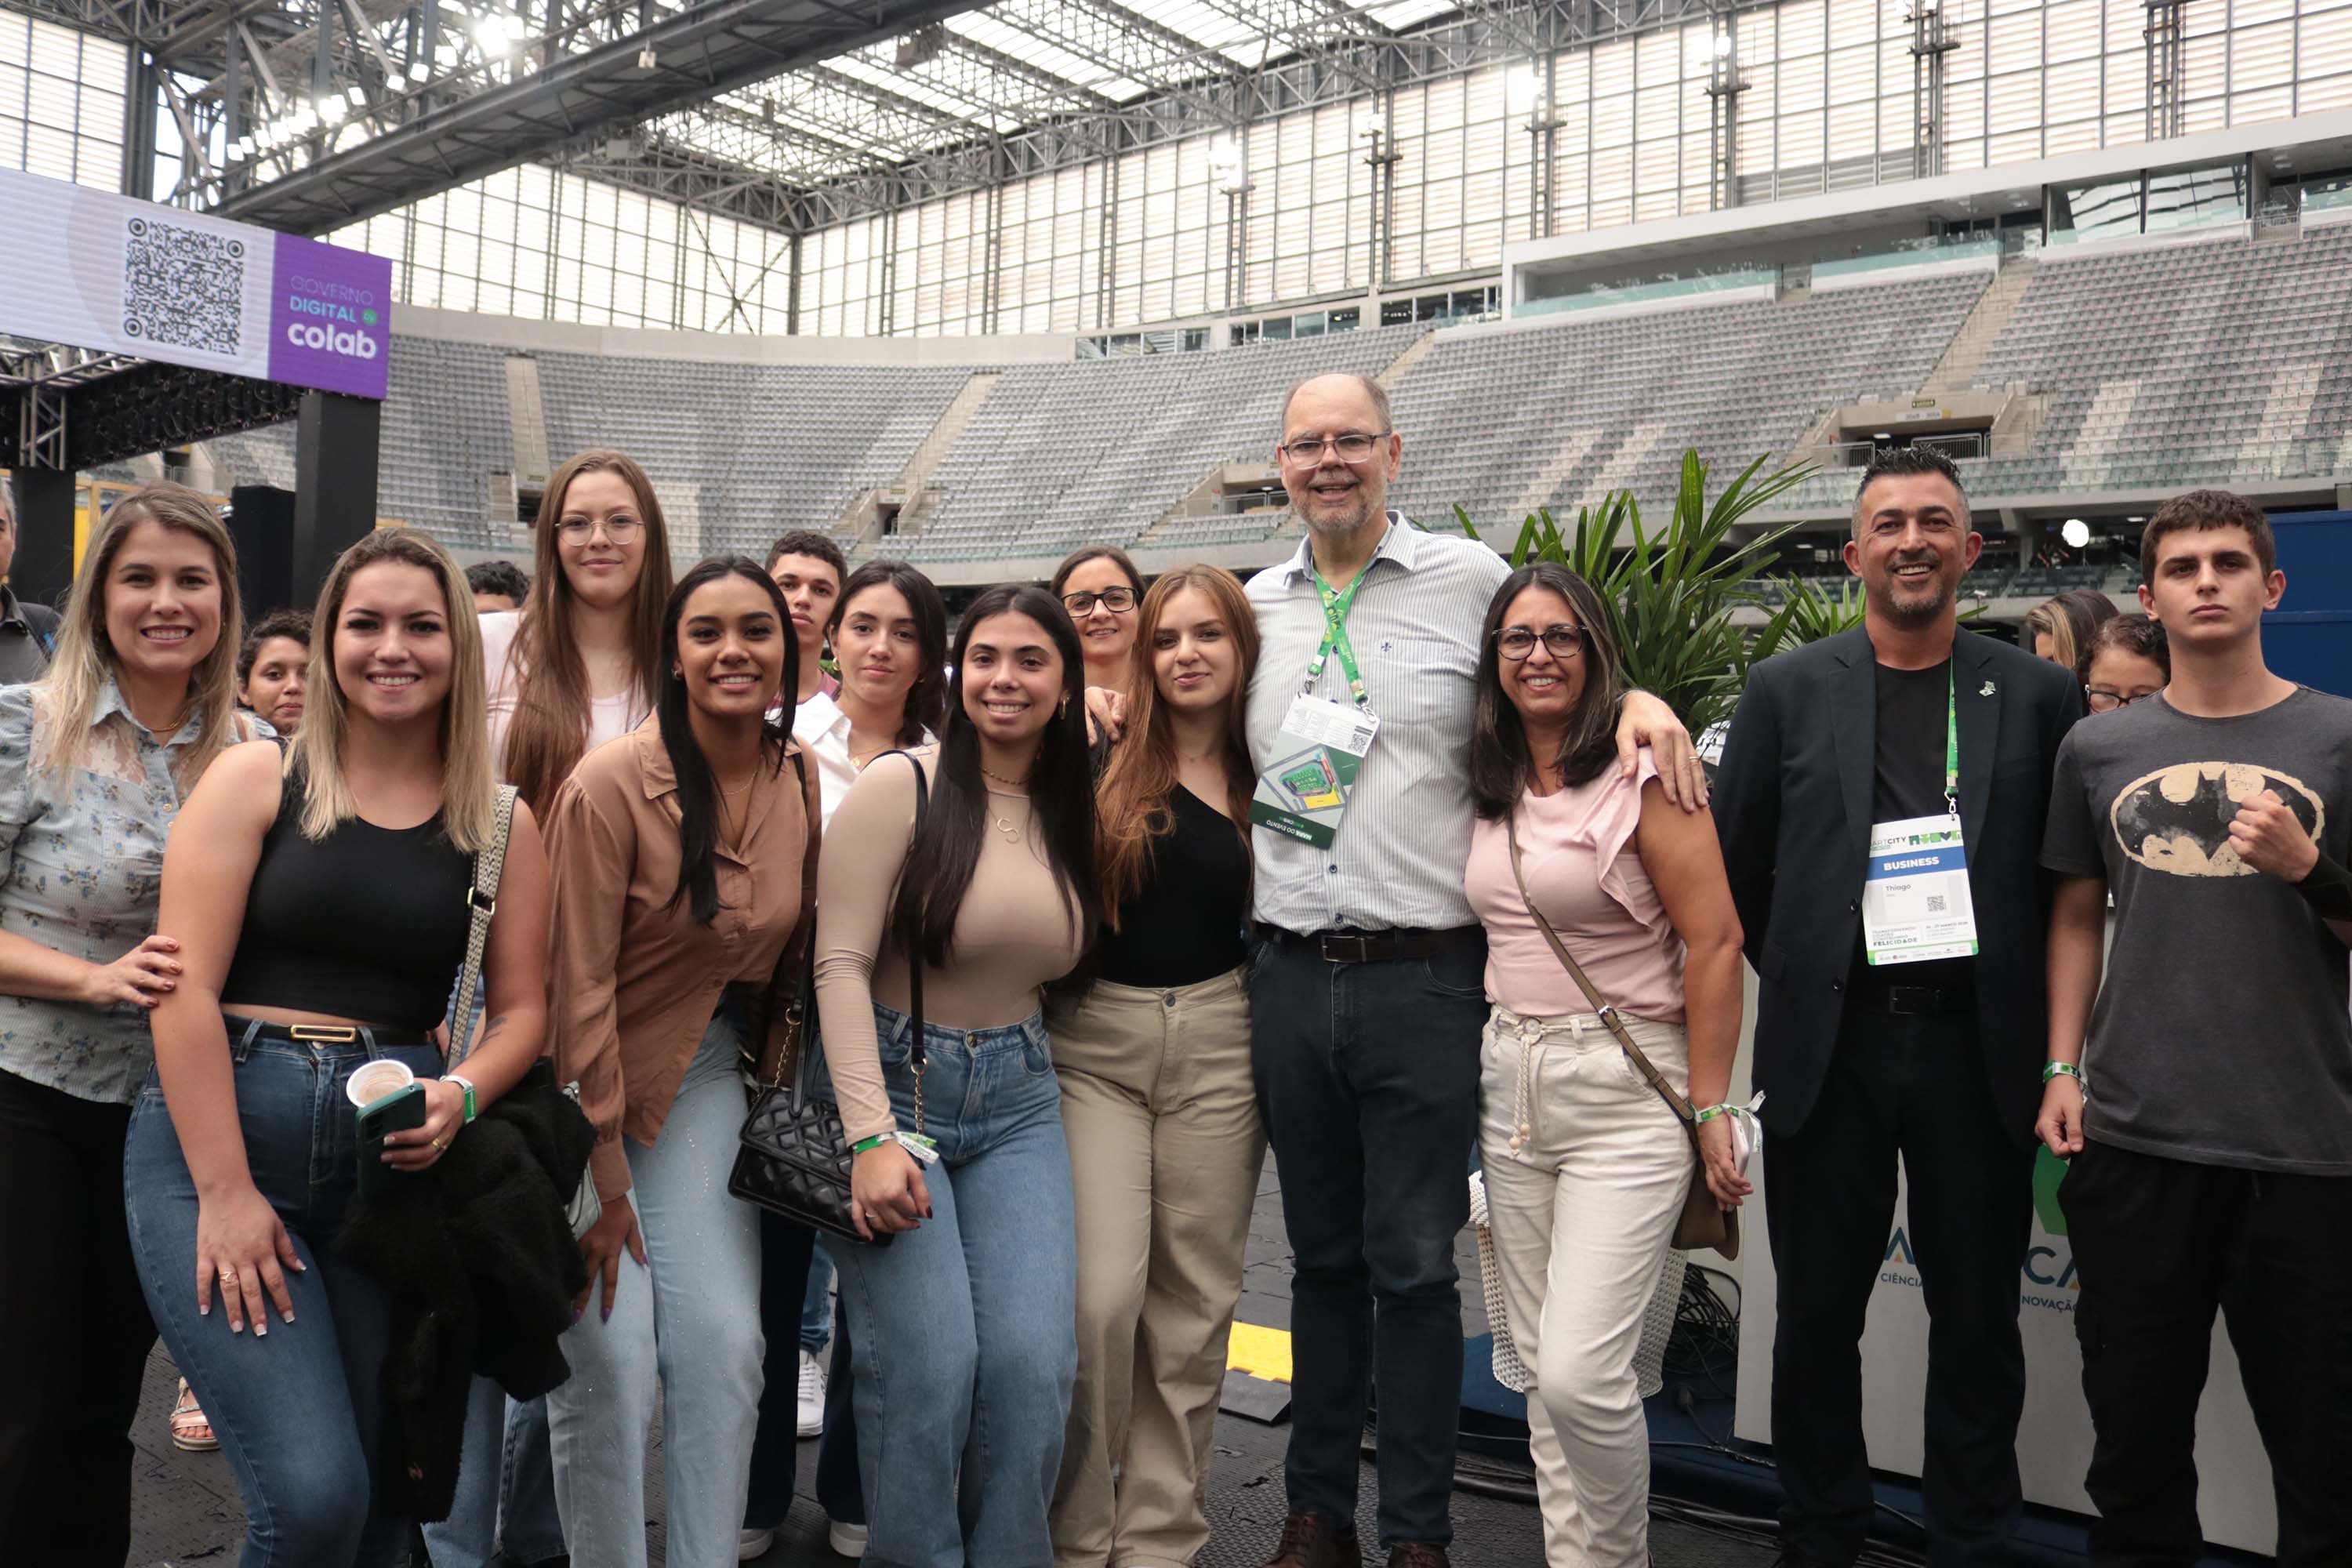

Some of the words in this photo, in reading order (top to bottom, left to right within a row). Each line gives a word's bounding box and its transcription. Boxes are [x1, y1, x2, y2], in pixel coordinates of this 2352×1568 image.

[290, 275, 373, 305] GOVERNO
[289, 296, 357, 323] DIGITAL
[287, 323, 377, 359] colab
[1871, 837, 1907, 847] ARTCITY
[1883, 856, 1940, 871] BUSINESS
[1886, 884, 1911, 892] Thiago
[1873, 937, 1917, 947] FELICIDADE
[2020, 1294, 2077, 1314] NOVAÇÃ
